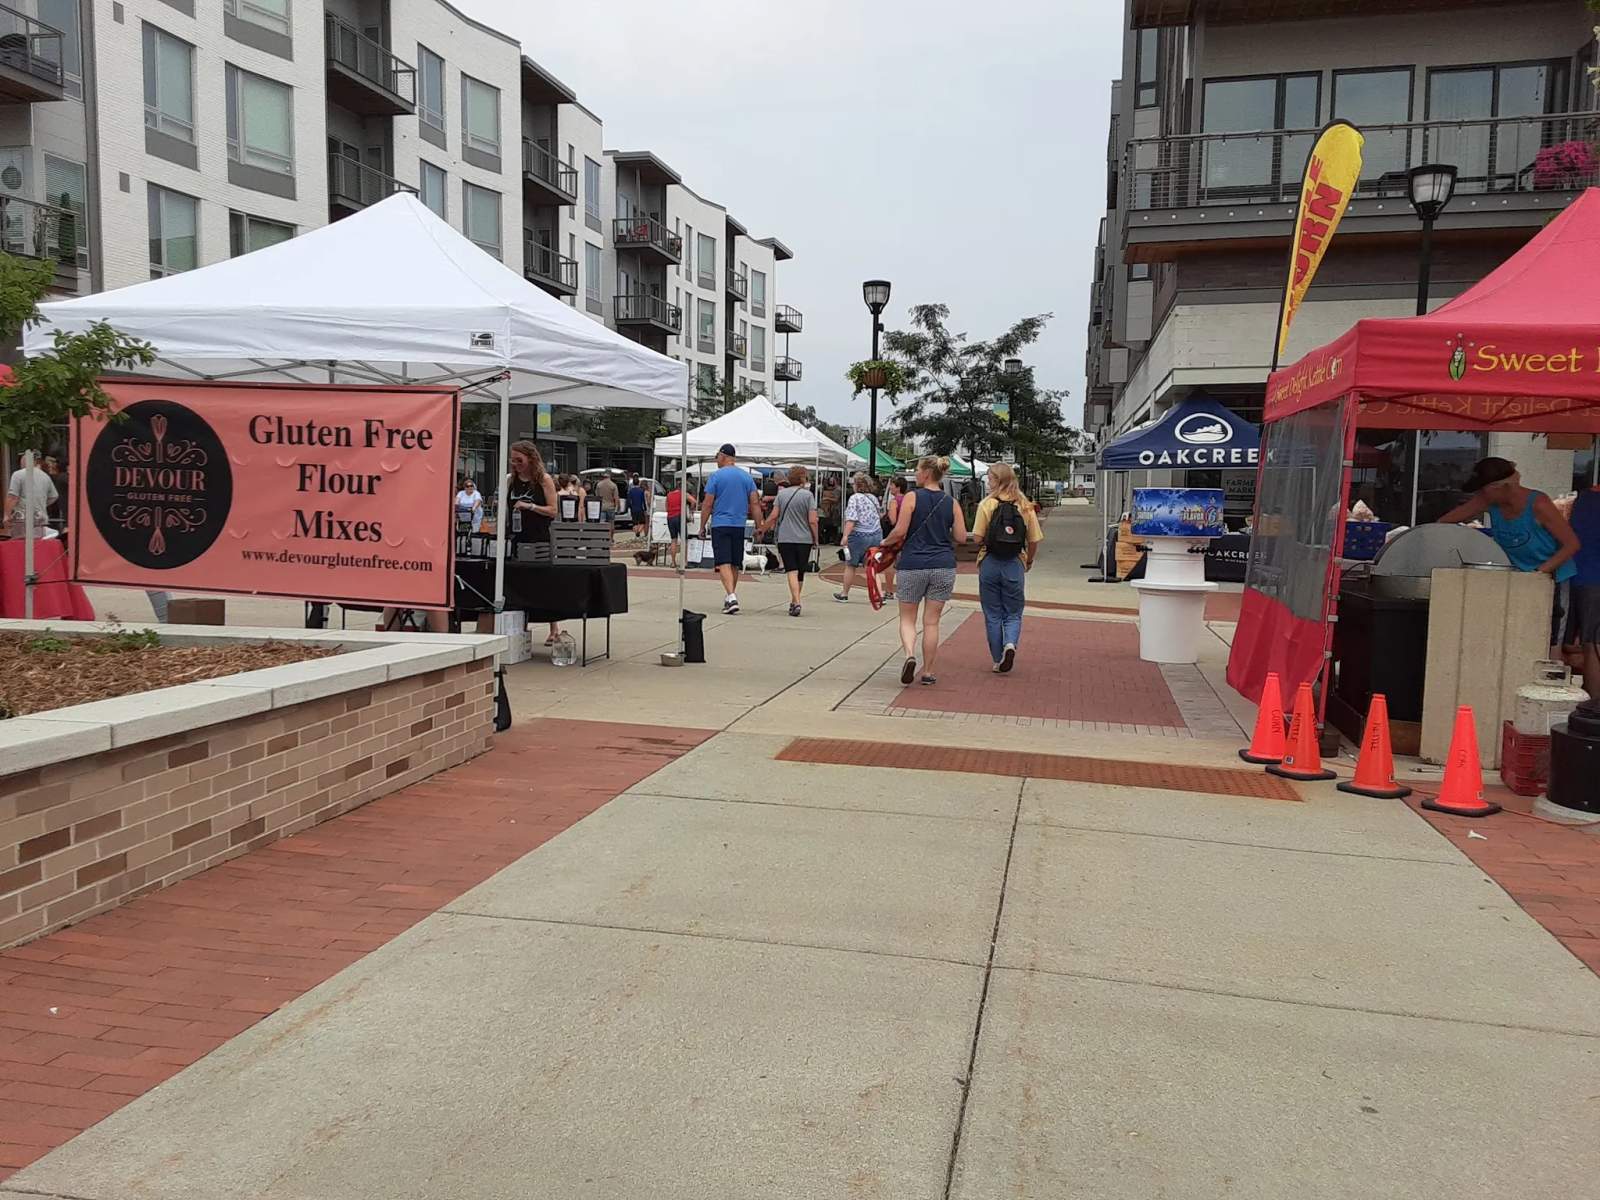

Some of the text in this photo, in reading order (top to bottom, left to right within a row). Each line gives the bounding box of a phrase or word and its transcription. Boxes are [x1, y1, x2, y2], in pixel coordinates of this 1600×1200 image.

[1473, 345, 1584, 373] Sweet
[249, 414, 433, 451] Gluten Free
[115, 466, 206, 491] DEVOUR
[296, 463, 382, 495] Flour
[127, 491, 192, 503] GLUTEN FREE
[292, 509, 383, 542] Mixes
[241, 549, 433, 572] www.devourglutenfree.com
